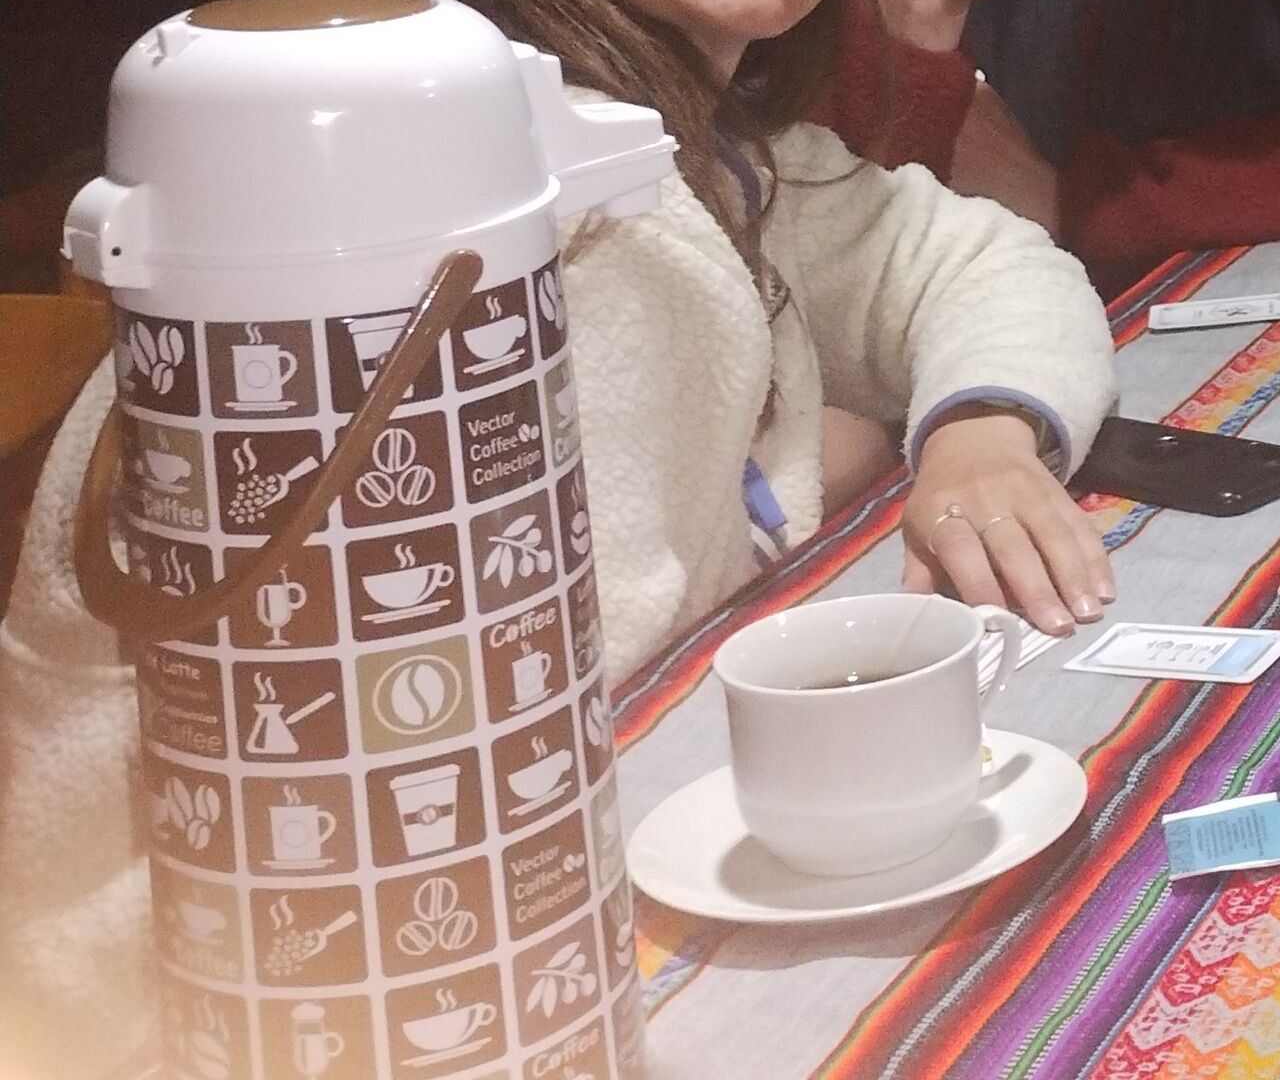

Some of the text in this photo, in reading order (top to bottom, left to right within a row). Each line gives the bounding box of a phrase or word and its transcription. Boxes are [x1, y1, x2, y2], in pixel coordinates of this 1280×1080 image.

[467, 411, 515, 437] Vector
[469, 435, 519, 461] Coffee
[472, 450, 541, 485] Collection
[489, 607, 557, 648] Coffee
[510, 844, 560, 877] Vector
[532, 1028, 600, 1077] Coffee
